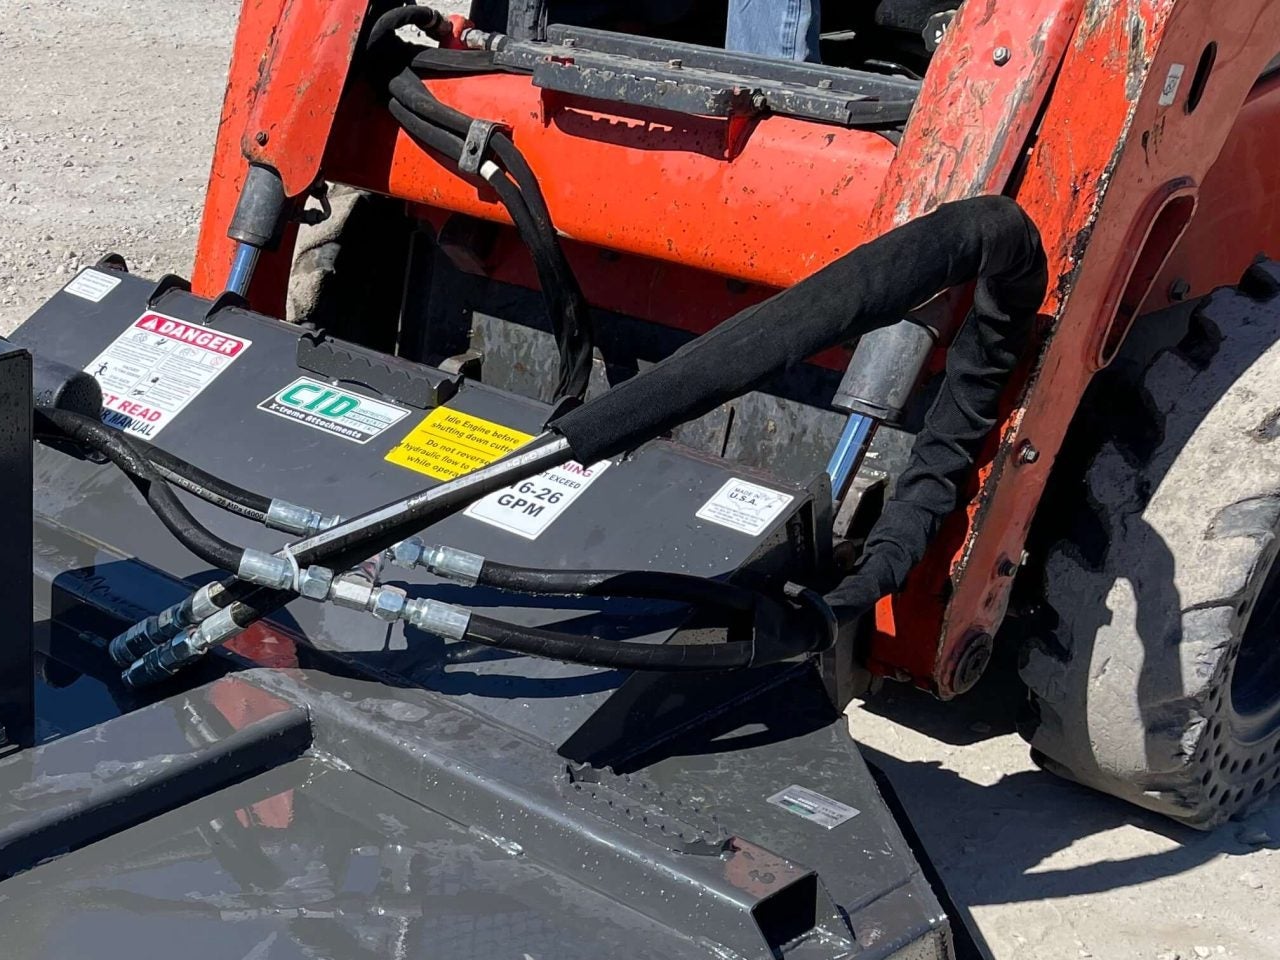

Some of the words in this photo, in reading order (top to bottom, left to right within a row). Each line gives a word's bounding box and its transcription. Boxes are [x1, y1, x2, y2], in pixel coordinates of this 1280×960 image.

[158, 318, 238, 353] DANGER
[117, 400, 162, 422] READ
[281, 383, 360, 417] CID
[109, 411, 155, 436] MANUAL
[269, 403, 307, 419] X-treme
[305, 415, 362, 439] Attachments
[431, 421, 464, 439] shutting
[465, 432, 489, 446] down
[445, 415, 460, 425] Idle
[462, 420, 491, 435] Engine
[492, 430, 520, 444] before
[403, 442, 441, 460] hydraulic
[442, 455, 461, 468] flow
[461, 462, 470, 470] to
[426, 439, 439, 448] Do
[440, 444, 456, 454] not
[407, 455, 431, 468] while
[549, 474, 581, 489] EXCEED
[734, 487, 753, 497] MADE
[497, 493, 545, 518] GPM
[729, 491, 758, 506] U.S.A.
